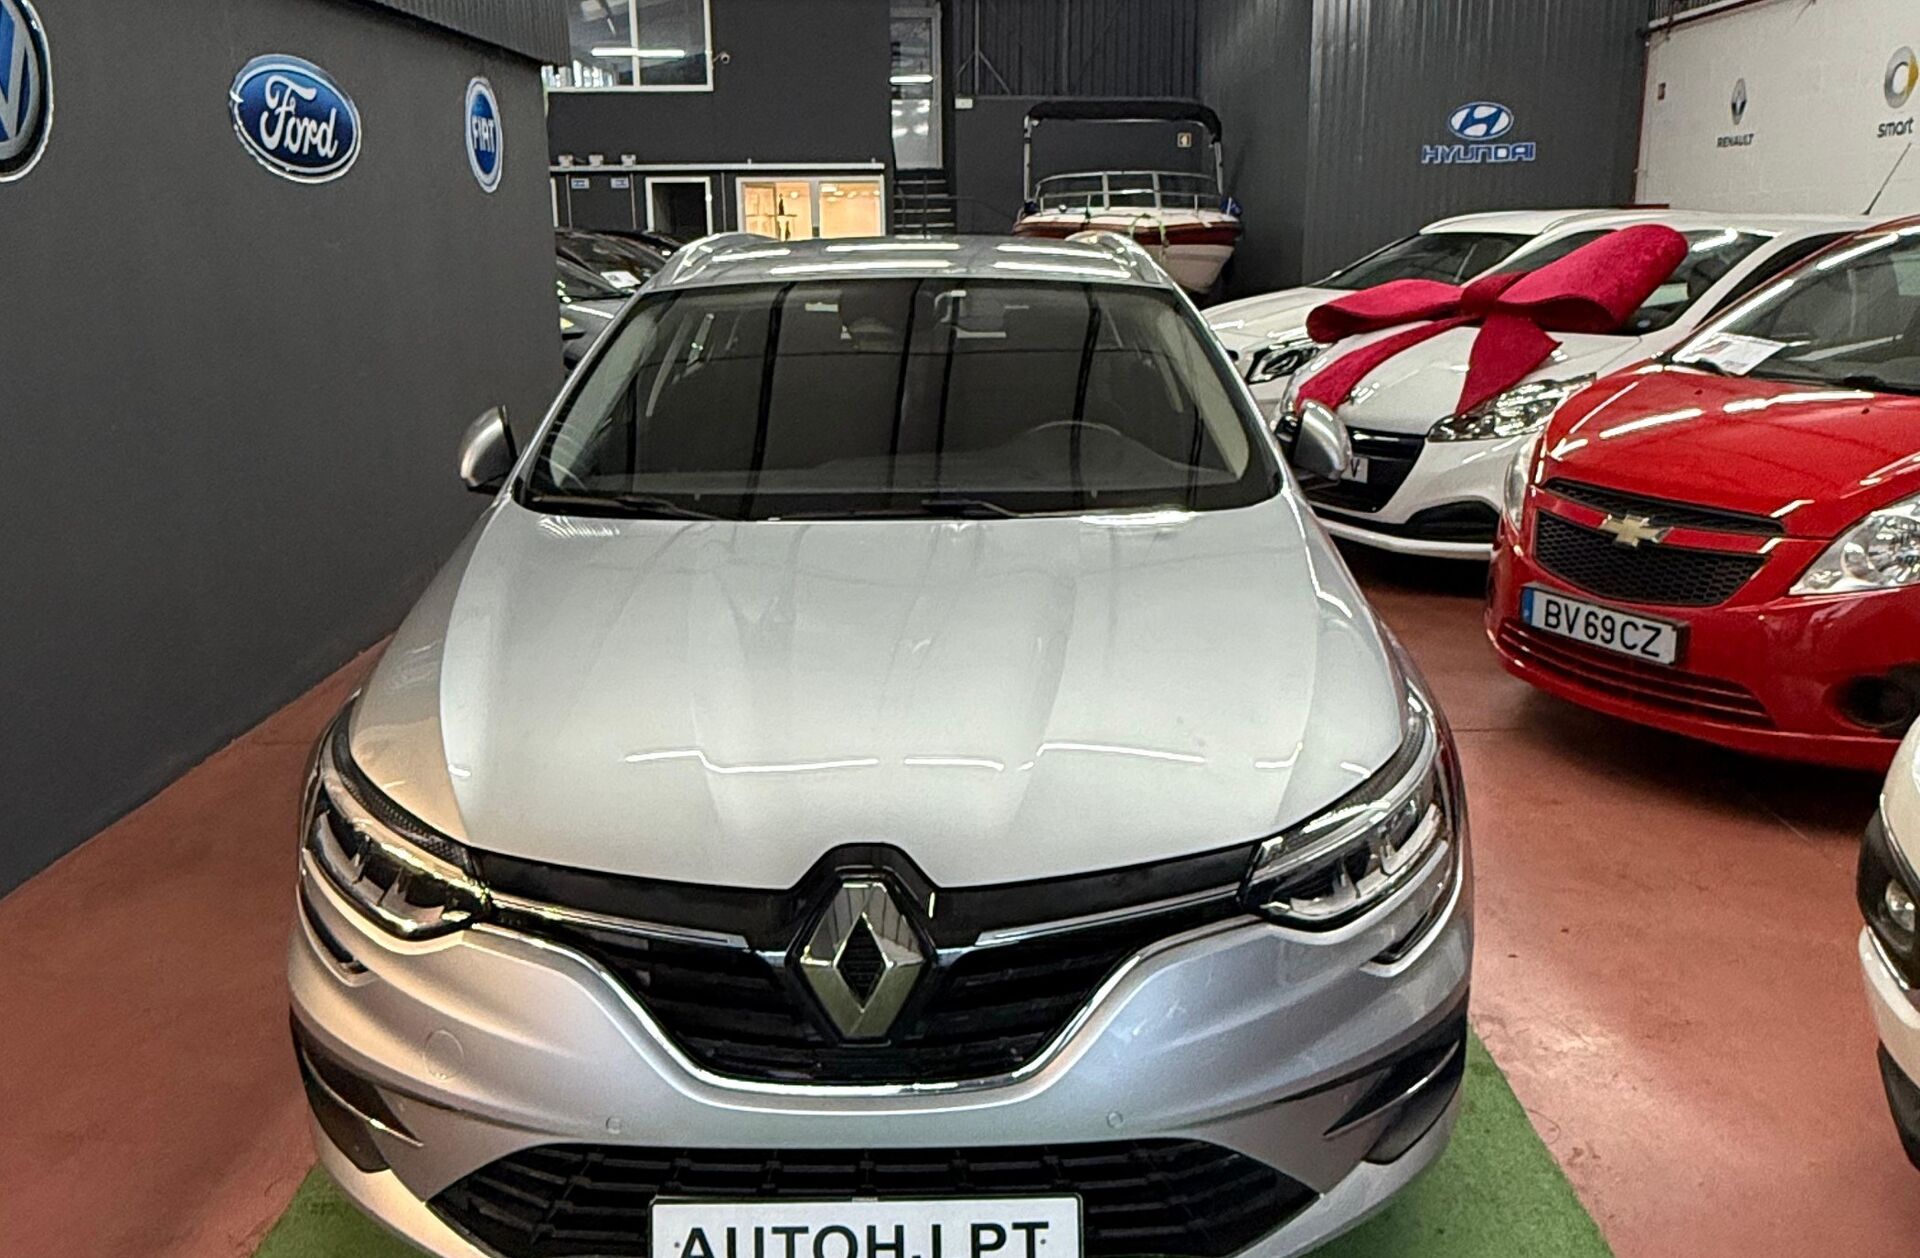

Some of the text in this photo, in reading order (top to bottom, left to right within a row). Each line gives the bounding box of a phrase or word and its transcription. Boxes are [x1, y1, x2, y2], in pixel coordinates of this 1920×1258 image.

[259, 75, 339, 159] Ford
[1877, 117, 1915, 138] smart
[472, 115, 495, 153] FIAT
[1717, 133, 1754, 148] RENAULT
[1421, 142, 1536, 163] HYUNDAI
